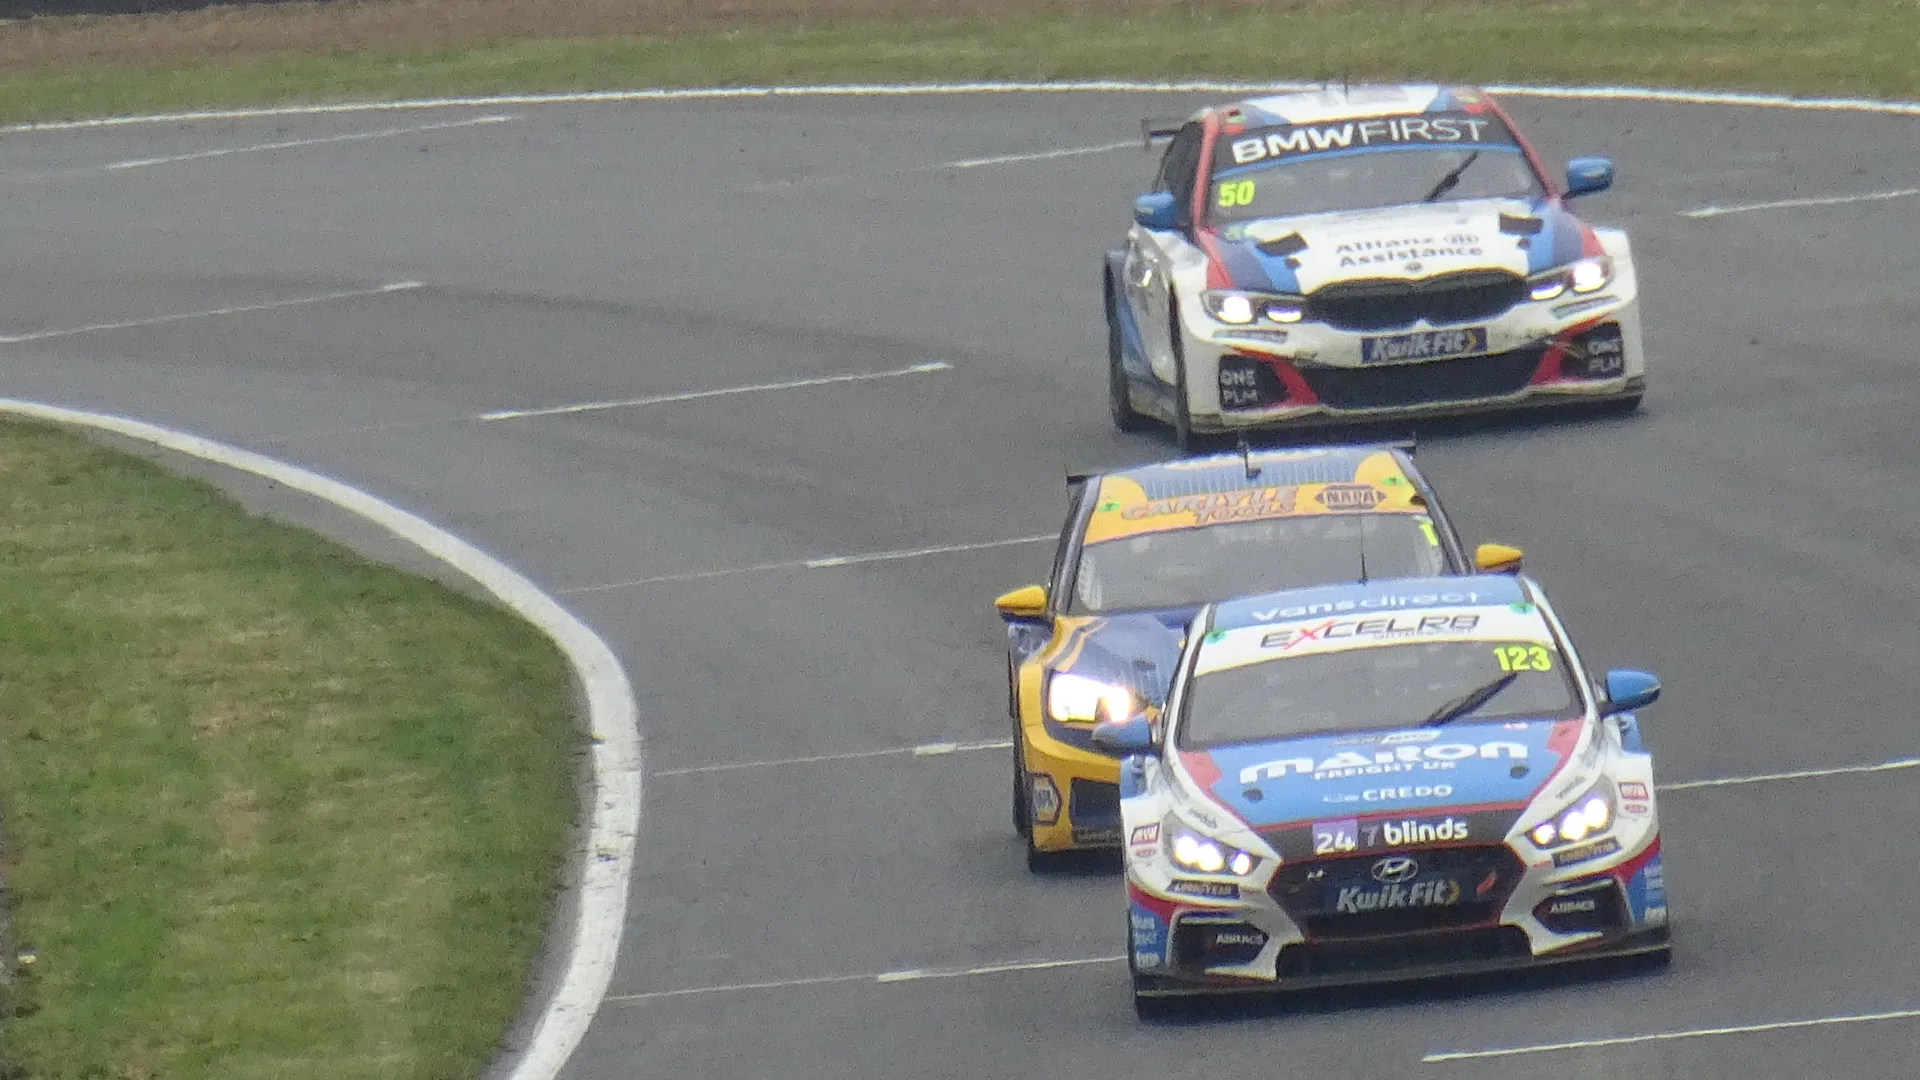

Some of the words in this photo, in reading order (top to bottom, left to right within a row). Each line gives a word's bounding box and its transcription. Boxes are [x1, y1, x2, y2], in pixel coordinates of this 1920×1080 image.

[1218, 179, 1255, 208] 50
[1339, 247, 1483, 268] Assistance
[1220, 368, 1256, 387] ONE
[1494, 645, 1552, 672] 123
[1314, 760, 1414, 780] FREIGHT
[1362, 784, 1454, 802] CREDO
[1384, 815, 1468, 847] blinds
